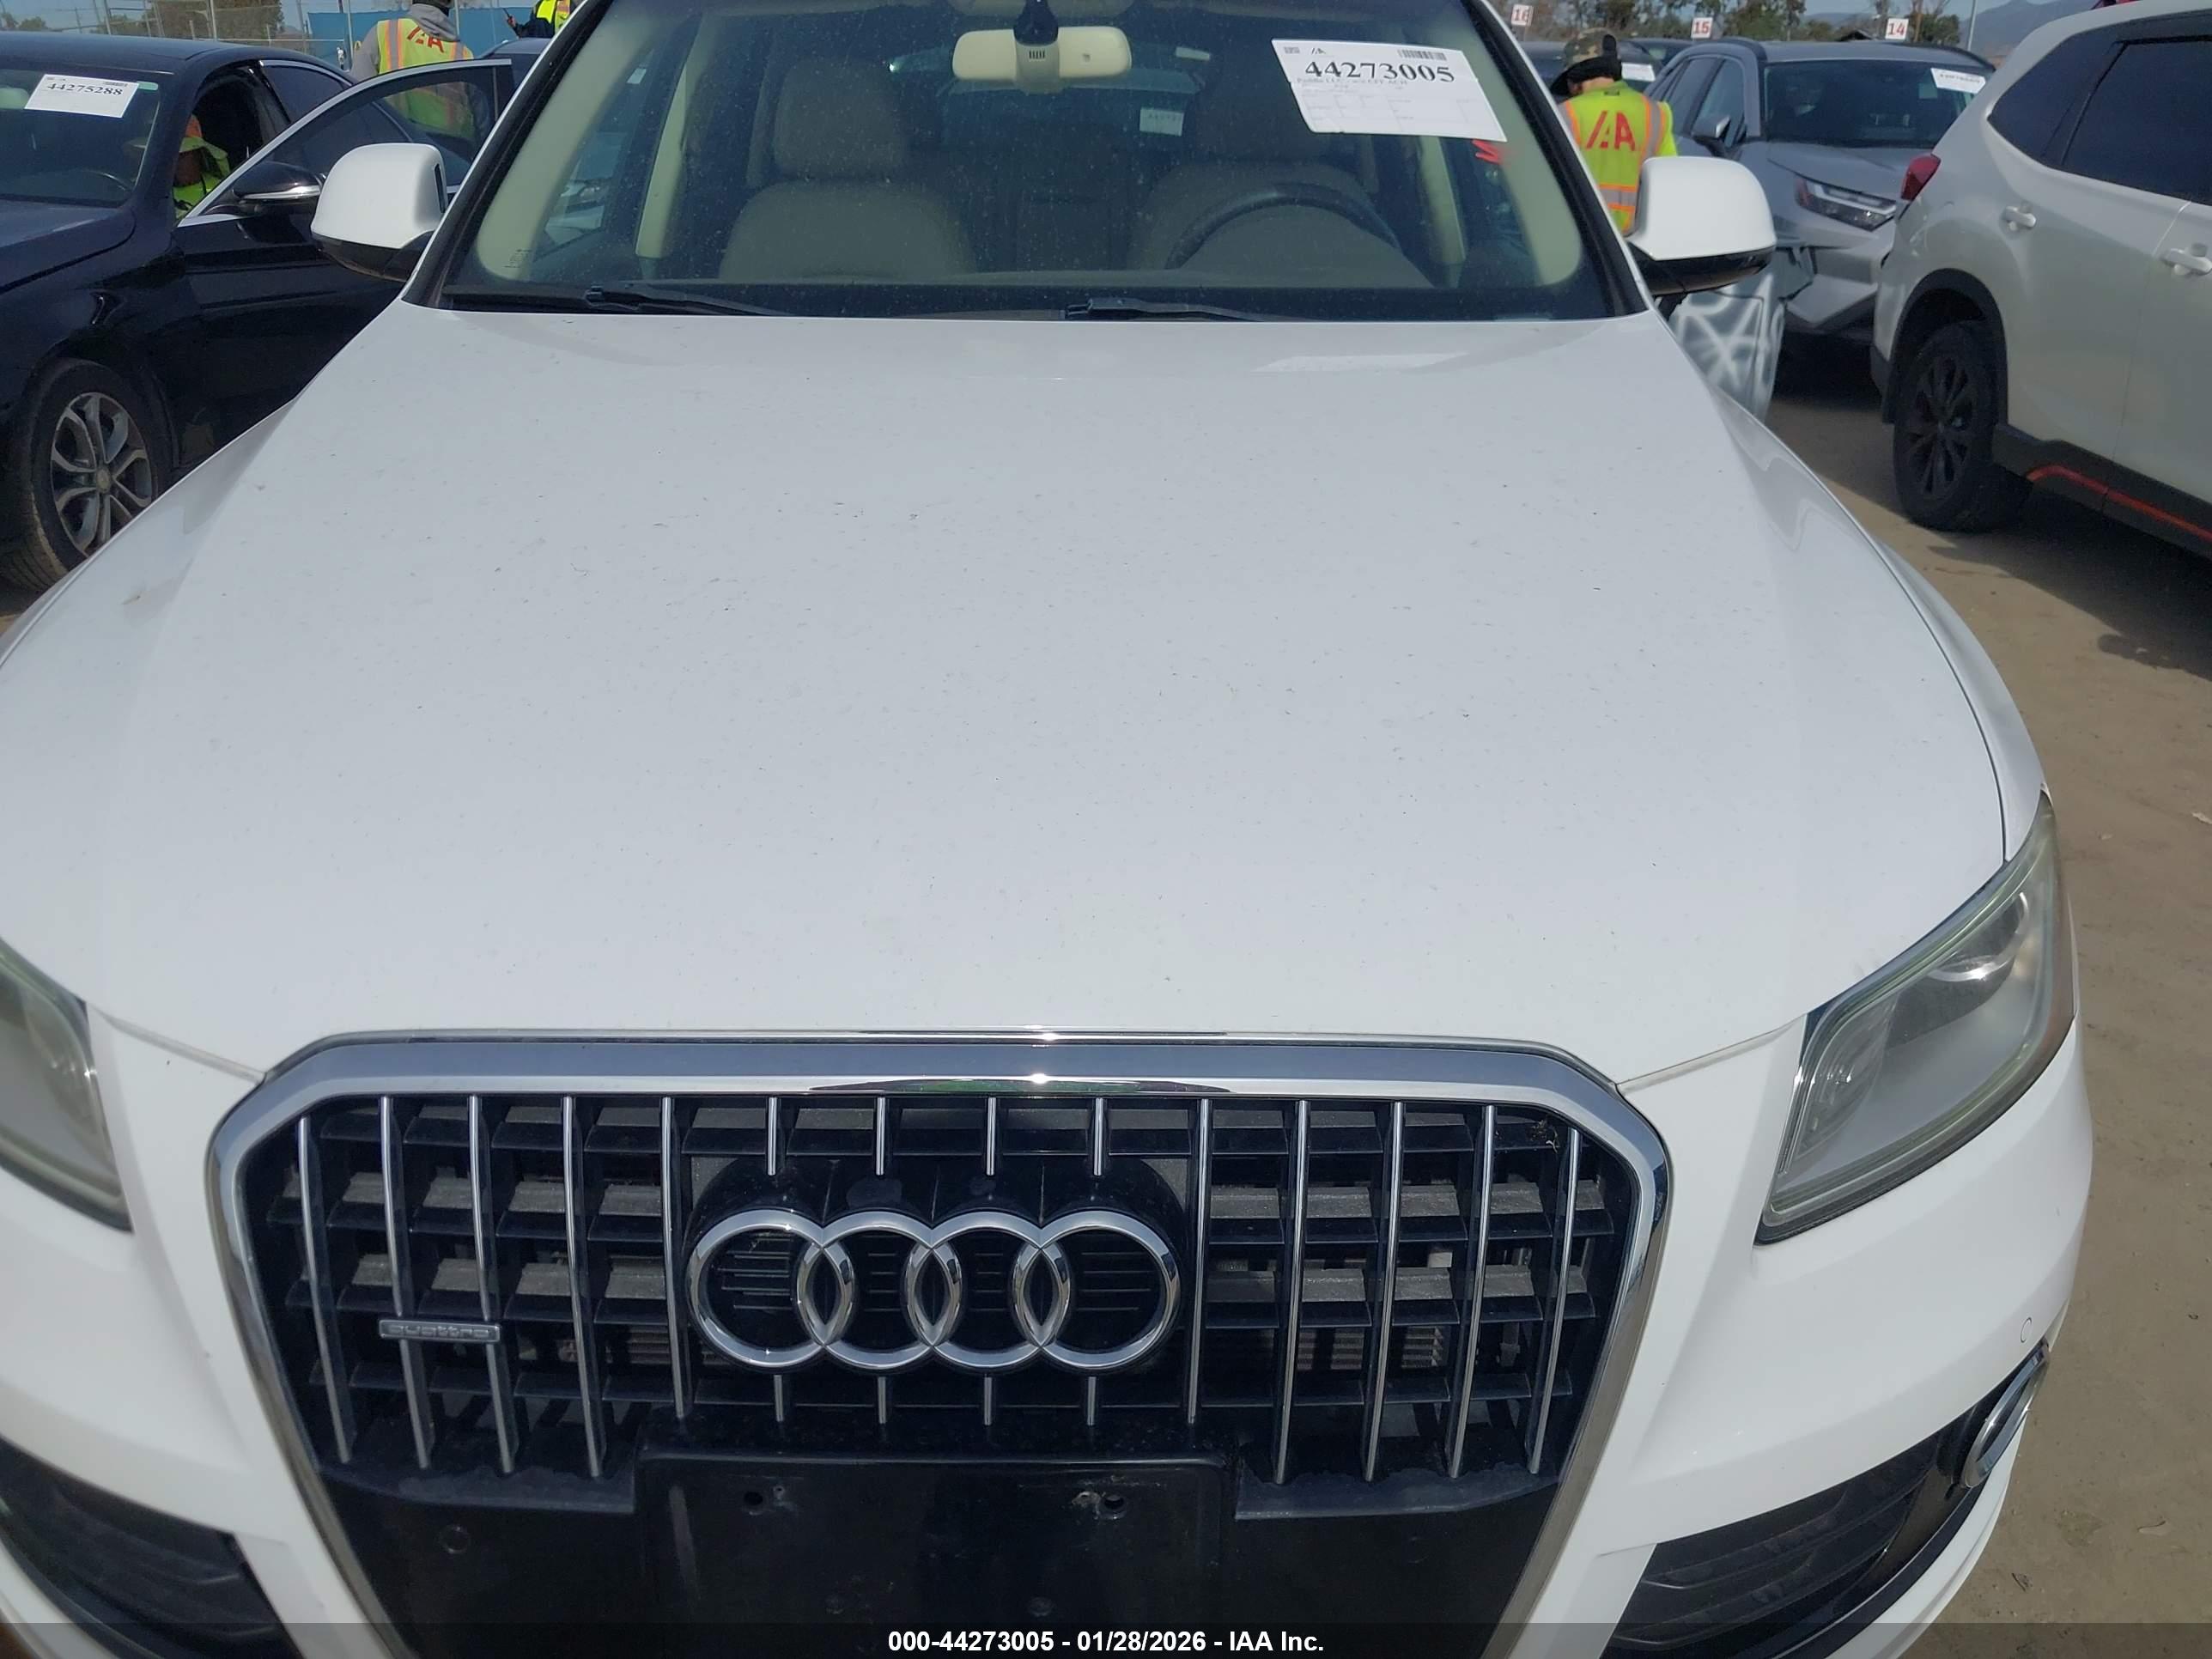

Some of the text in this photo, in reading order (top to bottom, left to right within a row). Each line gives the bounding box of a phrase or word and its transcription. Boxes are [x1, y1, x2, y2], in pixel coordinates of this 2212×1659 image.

[1693, 21, 1710, 34] 15
[1888, 22, 1907, 35] 14
[1304, 61, 1455, 83] 44273005
[47, 82, 123, 96] 44275288
[387, 1324, 489, 1339] quattro
